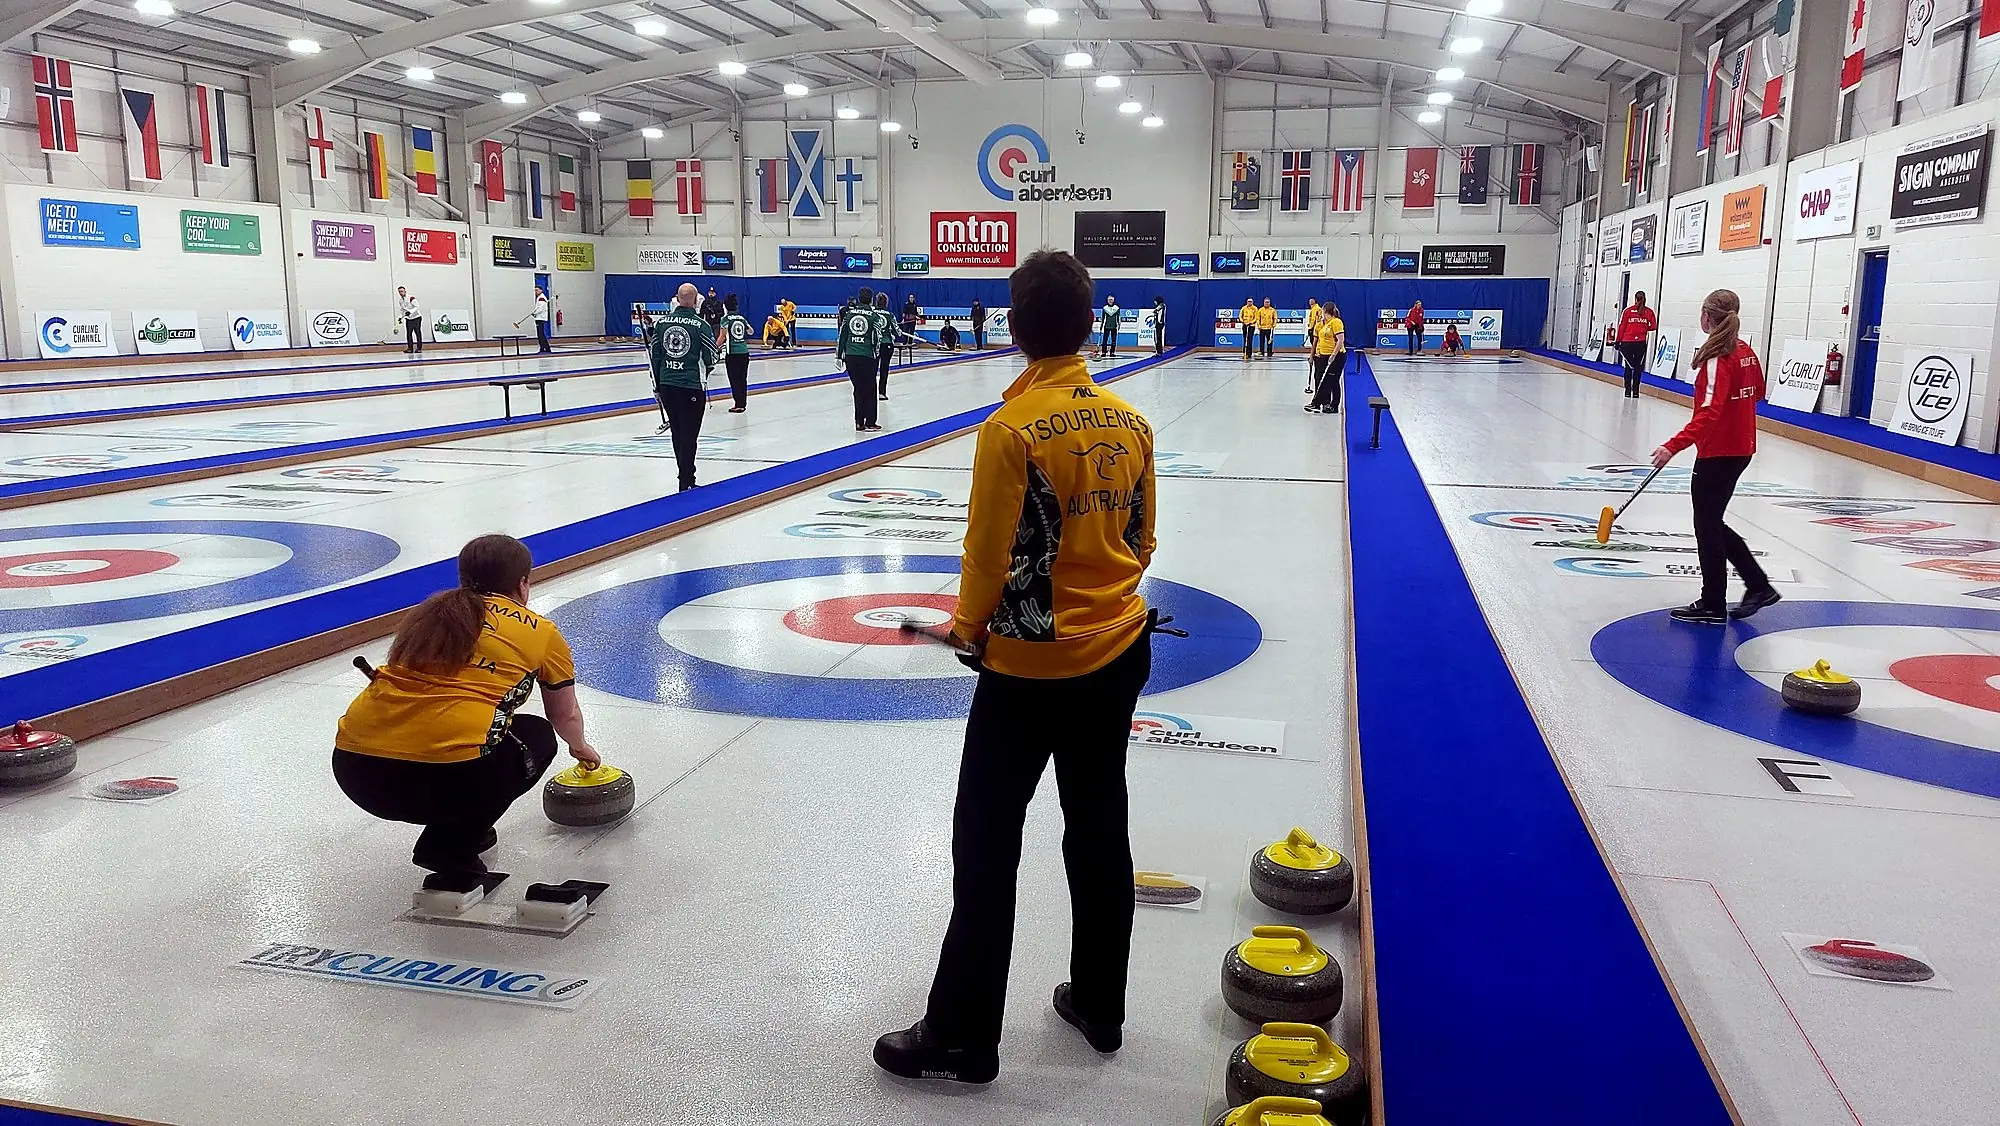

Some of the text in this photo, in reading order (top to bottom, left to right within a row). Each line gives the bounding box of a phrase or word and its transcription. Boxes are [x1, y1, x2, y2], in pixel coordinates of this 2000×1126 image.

[1018, 166, 1056, 184] curl
[1898, 148, 1981, 193] SIGN COMPANY
[1940, 173, 1971, 187] ABERDEEN
[1018, 184, 1112, 202] aberdeen
[1800, 188, 1832, 219] CHAP
[46, 204, 78, 219] ICE TO
[48, 218, 104, 234] MEET YOU...
[186, 216, 230, 230] KEEP YOUR
[937, 215, 1009, 242] mtm
[316, 224, 354, 238] SWEEP INTO
[406, 232, 428, 243] ICE AND
[638, 250, 680, 258] ABERDEEN
[798, 250, 828, 258] Airparks
[937, 244, 1009, 252] CONSTRUCTION
[1252, 250, 1279, 262] ABZ
[316, 316, 344, 326] Jet
[72, 324, 99, 334] CURLING
[169, 328, 196, 340] CLEAN
[322, 326, 346, 334] Ice
[73, 333, 102, 343] CHANNEL
[665, 360, 685, 370] MEX
[1791, 362, 1824, 380] CURLIT
[1913, 367, 1956, 389] Jet
[1916, 388, 1952, 410] Ice
[1020, 407, 1150, 446] TSOURLENES
[1066, 488, 1133, 519] AUTRALIA
[1150, 729, 1202, 739] curl
[1146, 736, 1278, 754] aberdeen
[1756, 758, 1833, 793] F
